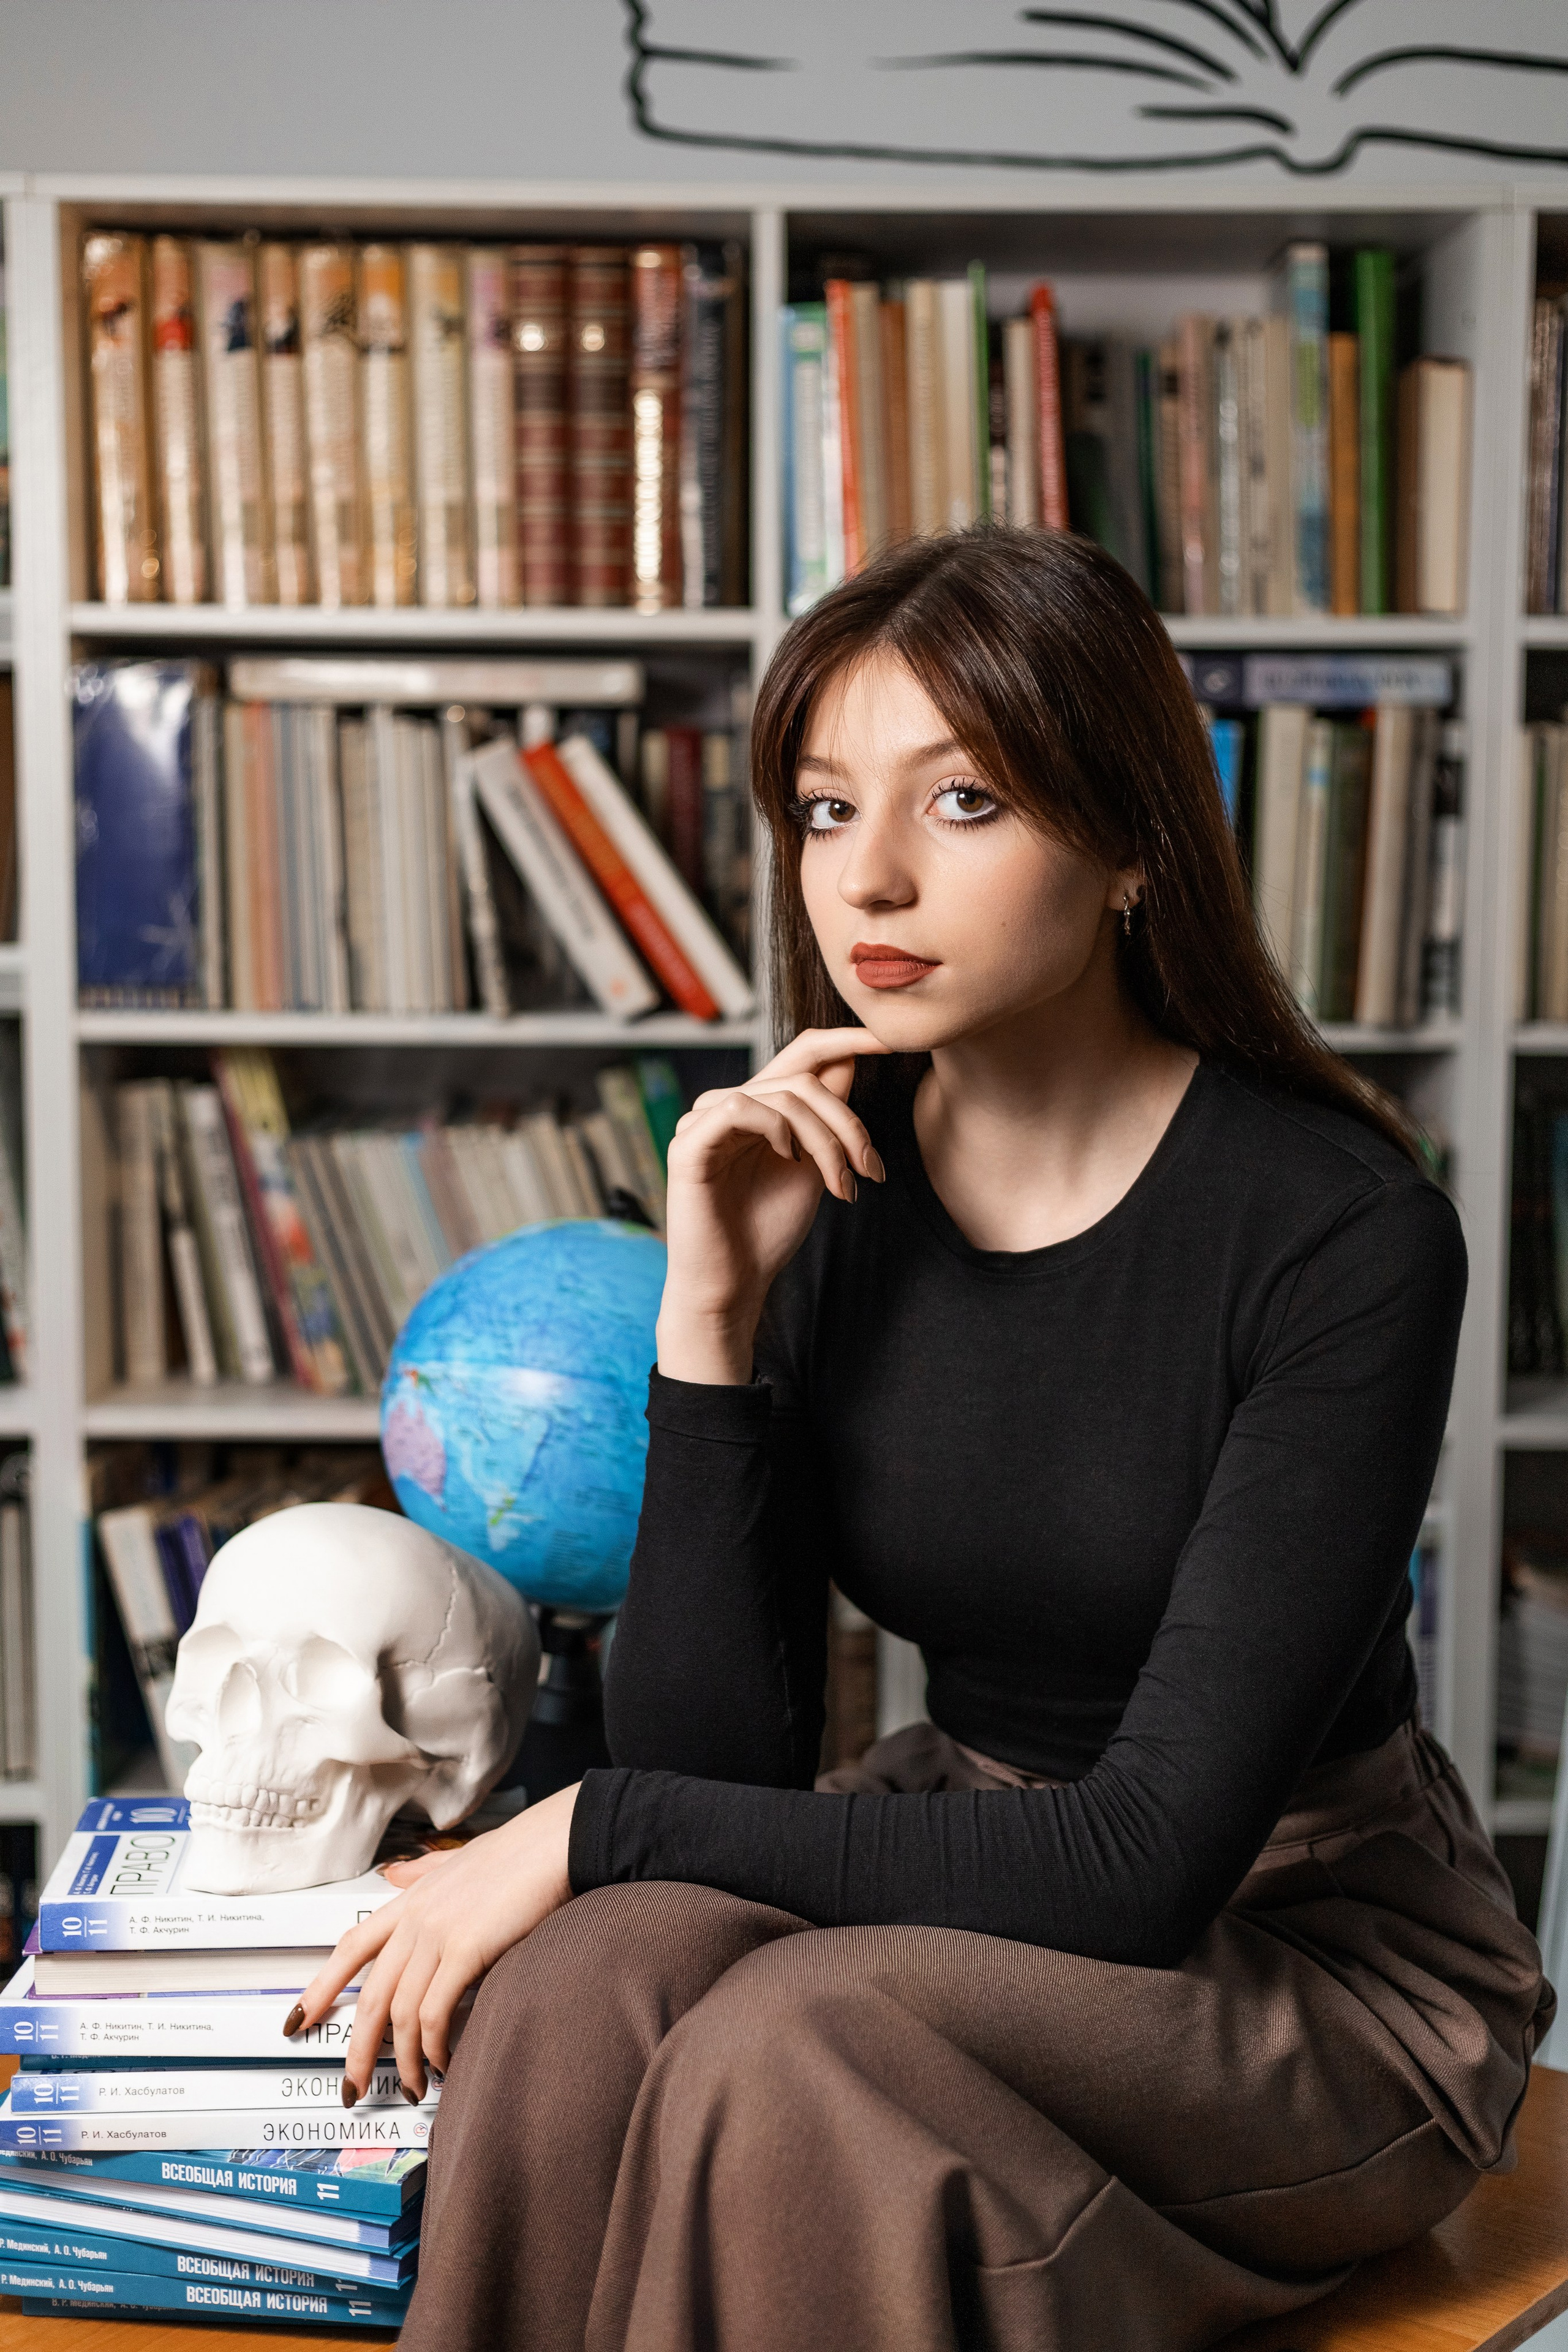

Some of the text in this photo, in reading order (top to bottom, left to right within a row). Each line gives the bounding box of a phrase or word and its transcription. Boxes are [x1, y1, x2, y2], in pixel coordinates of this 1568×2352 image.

[110, 1834, 176, 1894] ПРАВО
[221, 1913, 265, 1922] Никитина,
[62, 1917, 82, 1938] 10
[88, 1919, 108, 1934] 11
[153, 1926, 189, 1935] Акчурин
[14, 2021, 34, 2042] 10
[40, 2024, 59, 2040] 11
[105, 2022, 144, 2031] Никитин,
[170, 2022, 214, 2032] Никитина,
[306, 2023, 393, 2044] ПРА
[34, 2083, 53, 2104] 10
[61, 2086, 80, 2101] 11
[99, 2087, 106, 2096] Р.
[125, 2086, 185, 2096] Хасбулатов
[17, 2127, 36, 2144] 10
[42, 2130, 62, 2143] 11
[107, 2130, 167, 2140] Хасбулатов
[263, 2122, 401, 2141] ЭКОНОМИКА
[41, 2150, 48, 2160] А.
[50, 2152, 58, 2162] О.
[59, 2152, 93, 2166] Чубарьян
[162, 2162, 297, 2196] ВСЕОБЩАЯ ИСТОРИЯ
[317, 2183, 339, 2200] 11
[7, 2239, 51, 2255] Мединский,
[55, 2244, 62, 2254] А.
[63, 2245, 72, 2256] О.
[72, 2246, 107, 2260] Чубарьян
[177, 2255, 315, 2288] ВСЕОБЩАЯ ИСТОРИЯ
[1, 2274, 114, 2293] Р. Мединский, А. О. Чубарьян
[186, 2286, 328, 2313] ВСЕОБЩАЯ ИСТОРИЯ
[349, 2300, 372, 2317] 11
